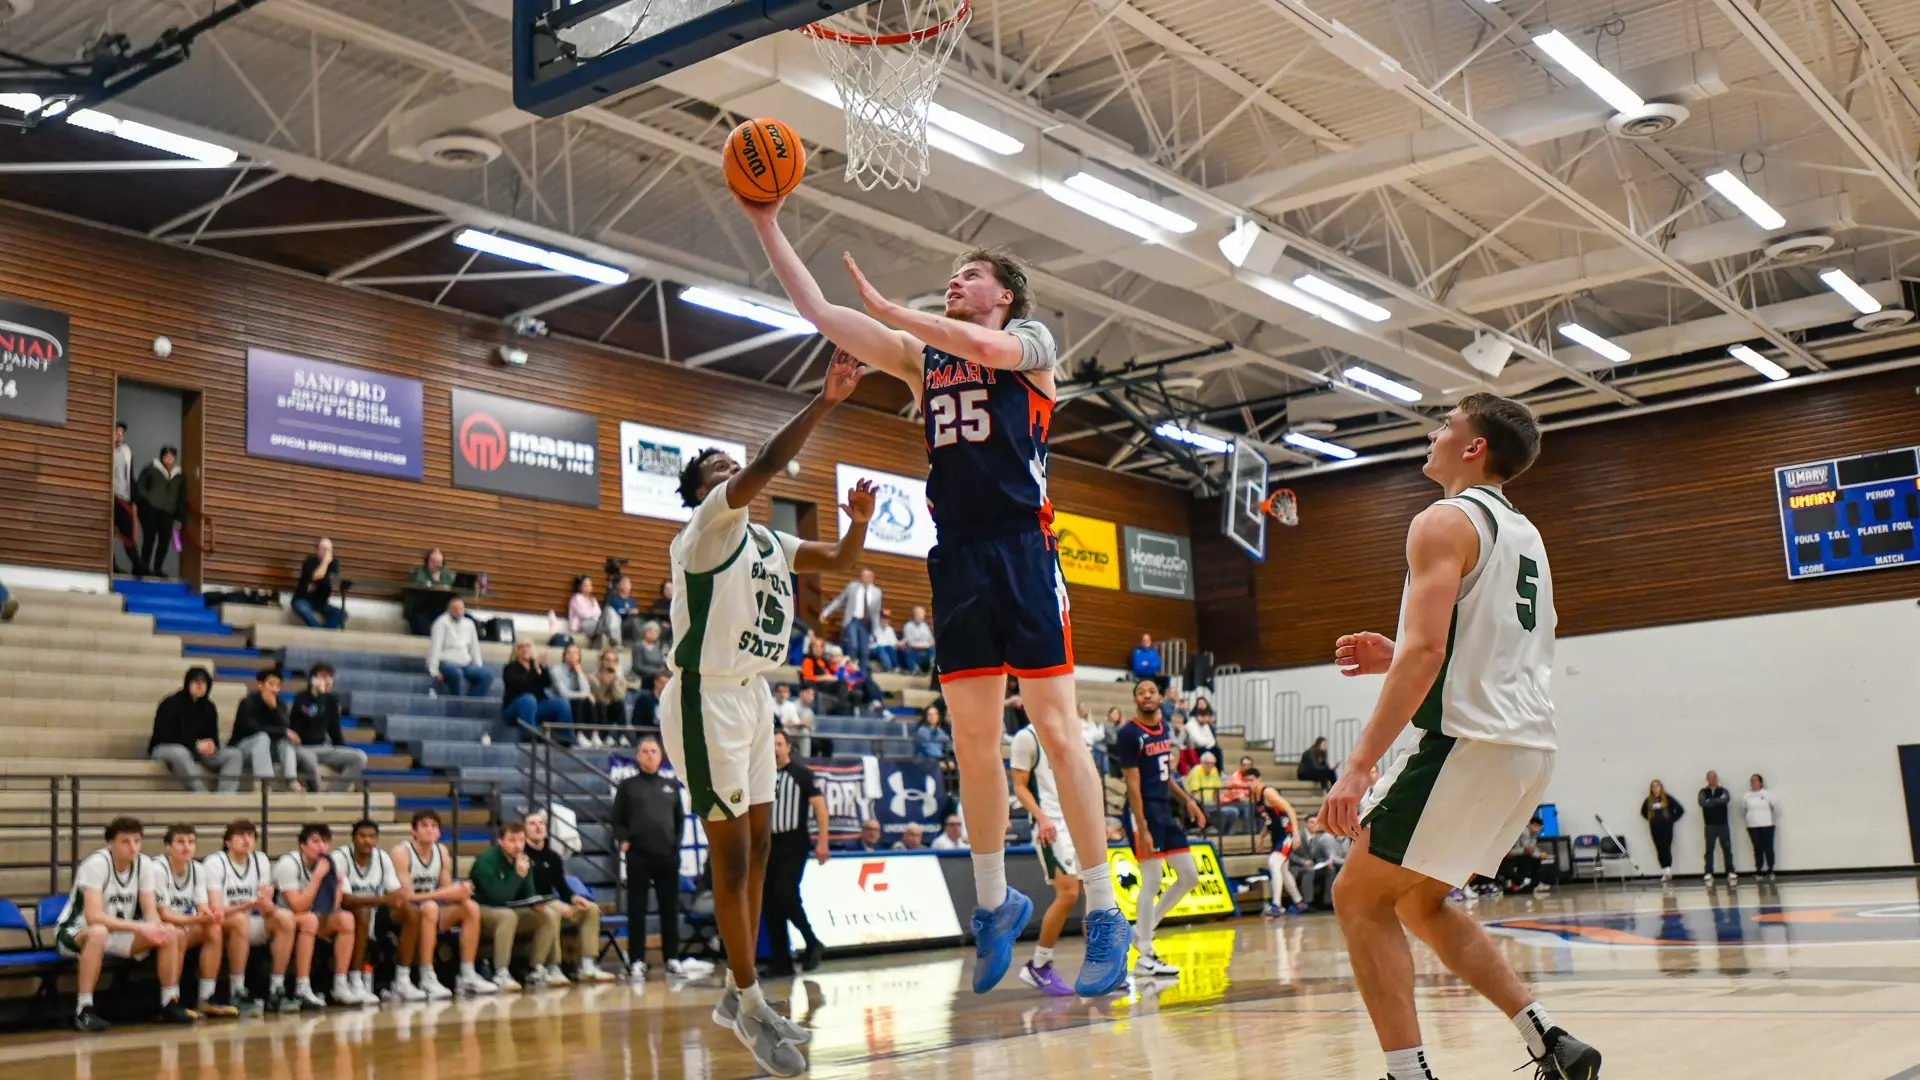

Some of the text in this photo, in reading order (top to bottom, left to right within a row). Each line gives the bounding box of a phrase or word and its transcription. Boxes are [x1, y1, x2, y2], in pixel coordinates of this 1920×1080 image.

[742, 126, 767, 178] Wilson
[764, 123, 788, 159] NCAA
[3, 350, 50, 372] PAINT
[293, 369, 387, 402] SANFORD
[277, 395, 402, 428] SPORTS MEDICINE
[930, 388, 992, 448] 25
[509, 431, 595, 463] mann
[1786, 466, 1829, 488] UMARY
[1789, 490, 1837, 509] UMARY
[1865, 489, 1896, 501] PERIOD
[1794, 533, 1821, 545] FOULS
[1827, 530, 1850, 541] T.O.L.
[1857, 521, 1914, 537] PLAYER FOUL
[1798, 563, 1825, 575] SCORE
[1874, 553, 1905, 565] MATCH
[1516, 554, 1539, 633] 5
[754, 590, 785, 636] 15
[1158, 755, 1169, 782] 5
[828, 904, 920, 928] Fireside
